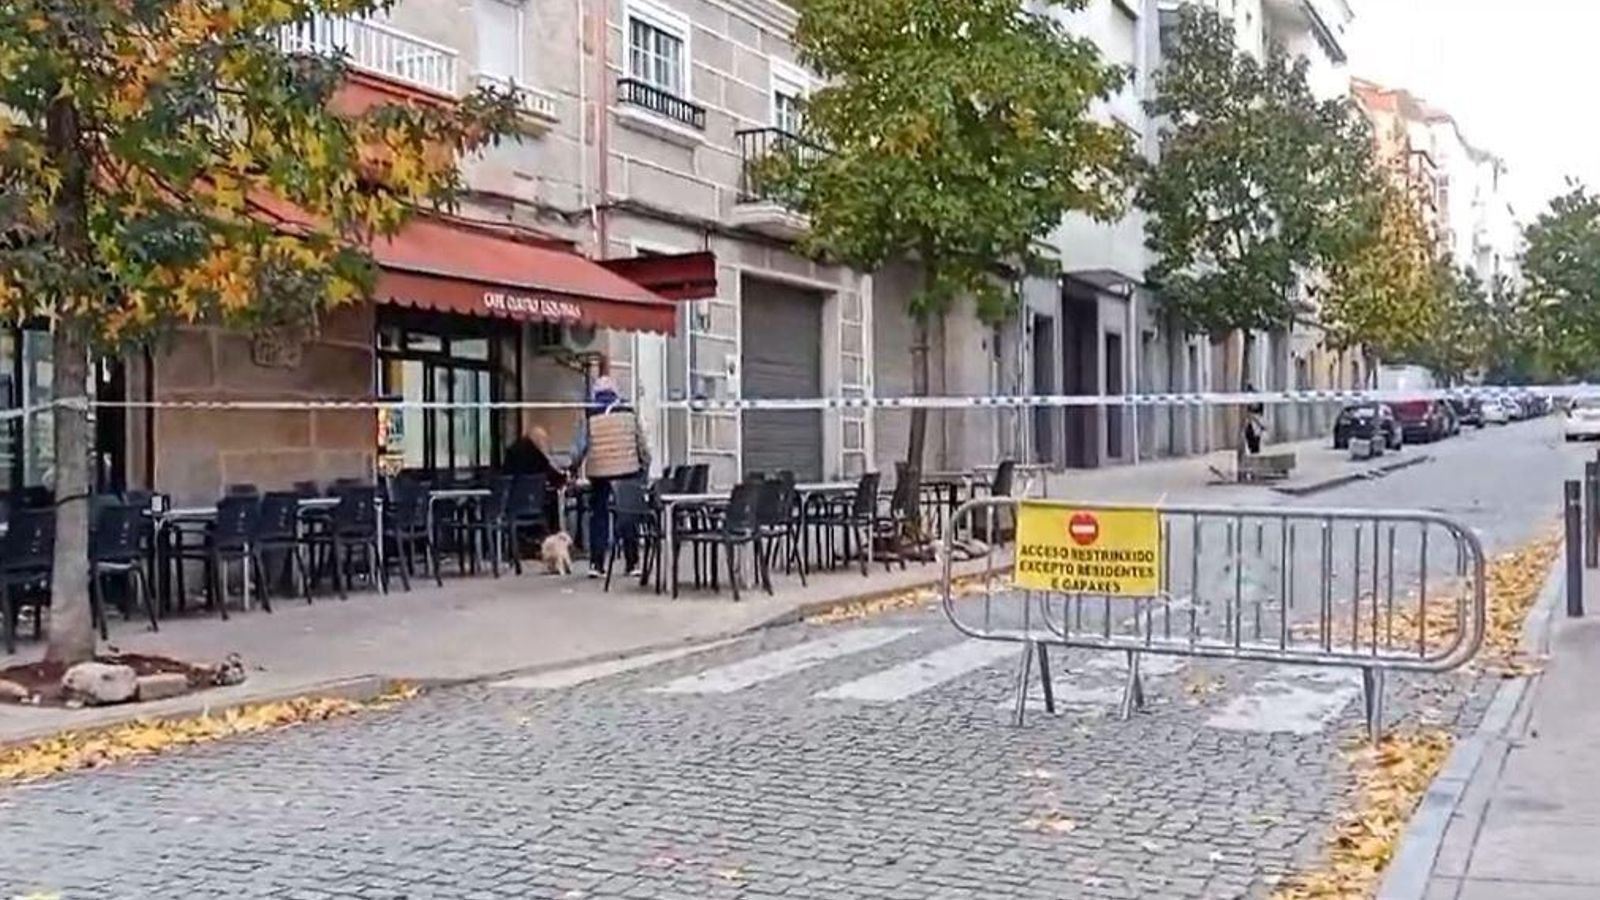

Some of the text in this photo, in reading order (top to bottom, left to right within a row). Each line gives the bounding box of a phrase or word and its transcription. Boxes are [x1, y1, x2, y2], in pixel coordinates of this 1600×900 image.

[1020, 545, 1154, 562] ACCESO RESTRINXIDO
[1019, 560, 1155, 578] EXCEPTO RESIDENTES
[1051, 580, 1059, 590] E
